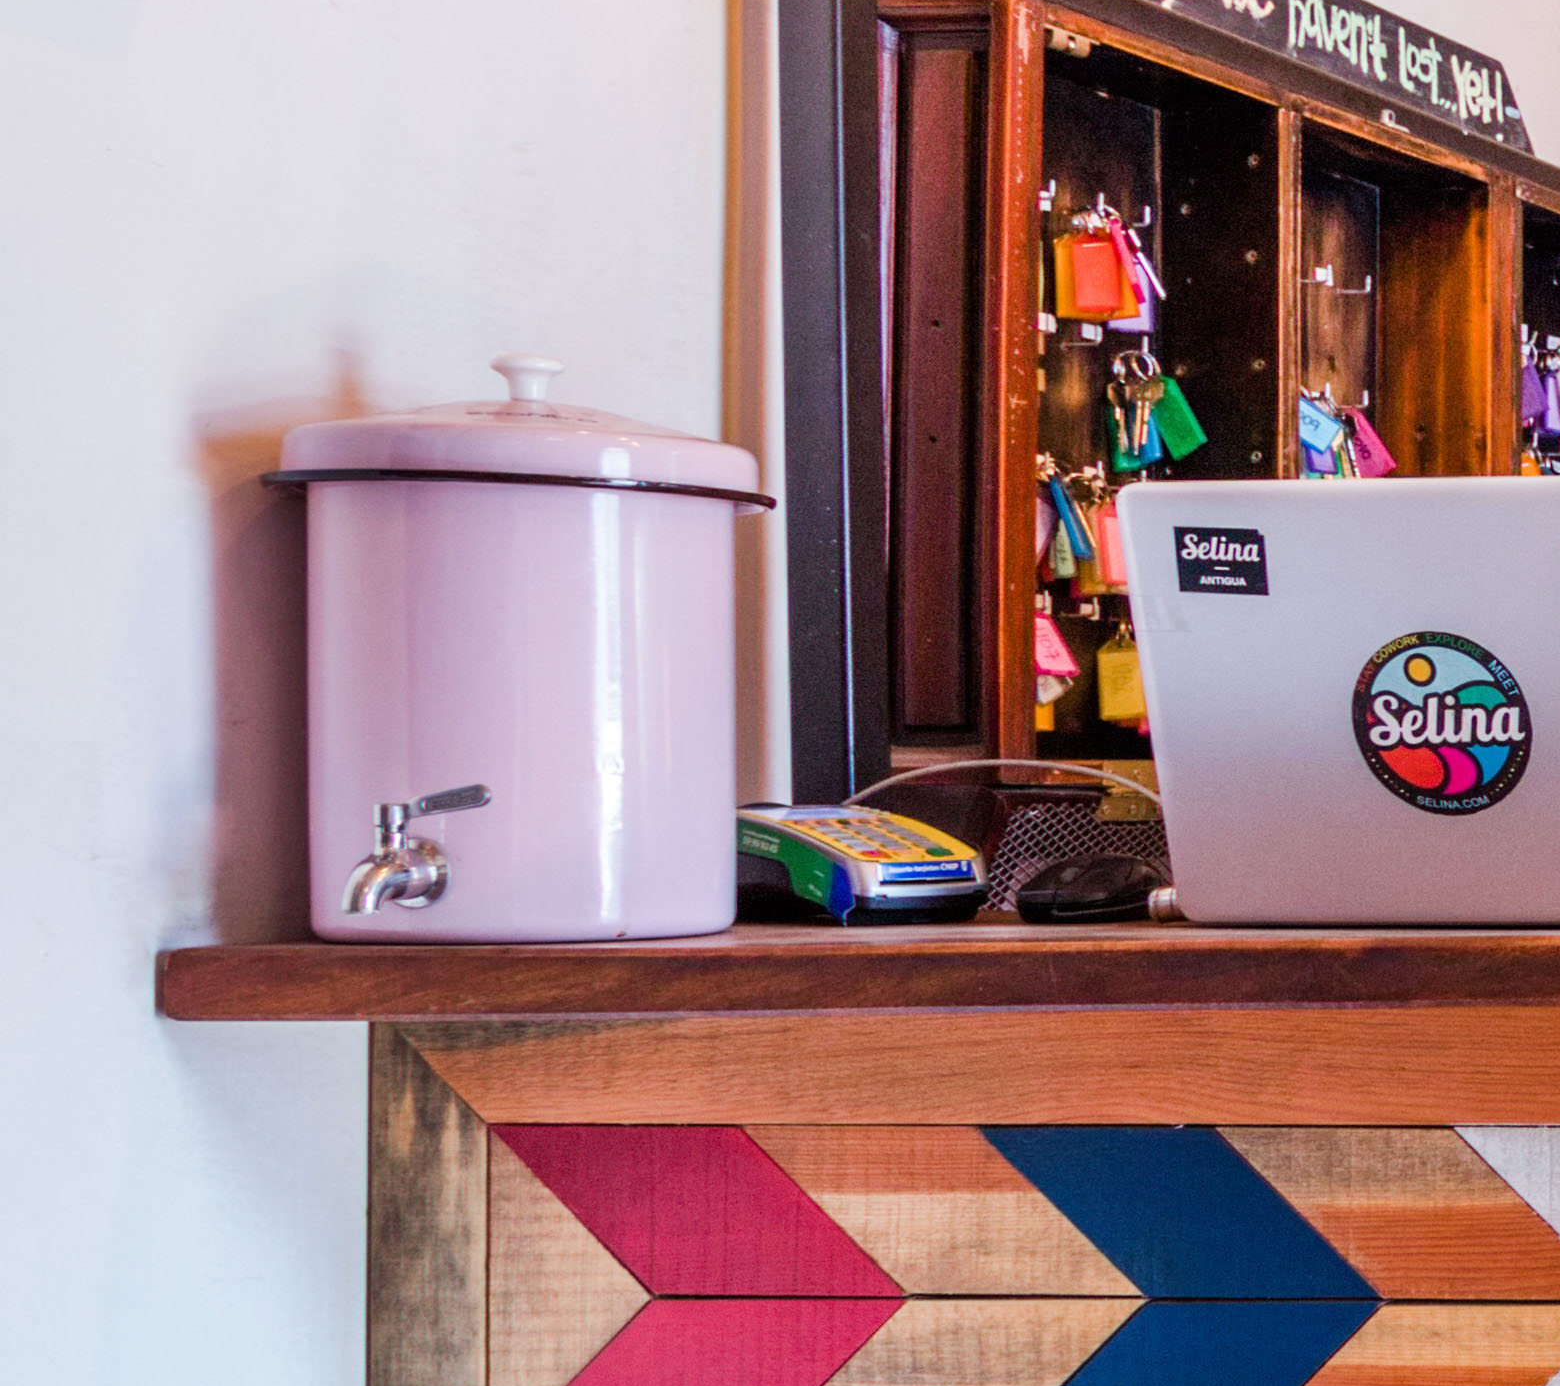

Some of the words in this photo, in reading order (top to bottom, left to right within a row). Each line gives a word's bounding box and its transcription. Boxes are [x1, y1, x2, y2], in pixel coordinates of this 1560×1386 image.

[1181, 533, 1261, 562] Selina
[1200, 575, 1248, 587] ANTIGUA
[1372, 634, 1419, 664] COWORK
[1425, 633, 1487, 659] EXPLORE
[1487, 659, 1521, 697] MEET
[1369, 693, 1526, 747] Selina
[1416, 795, 1491, 811] SELINA.COM
